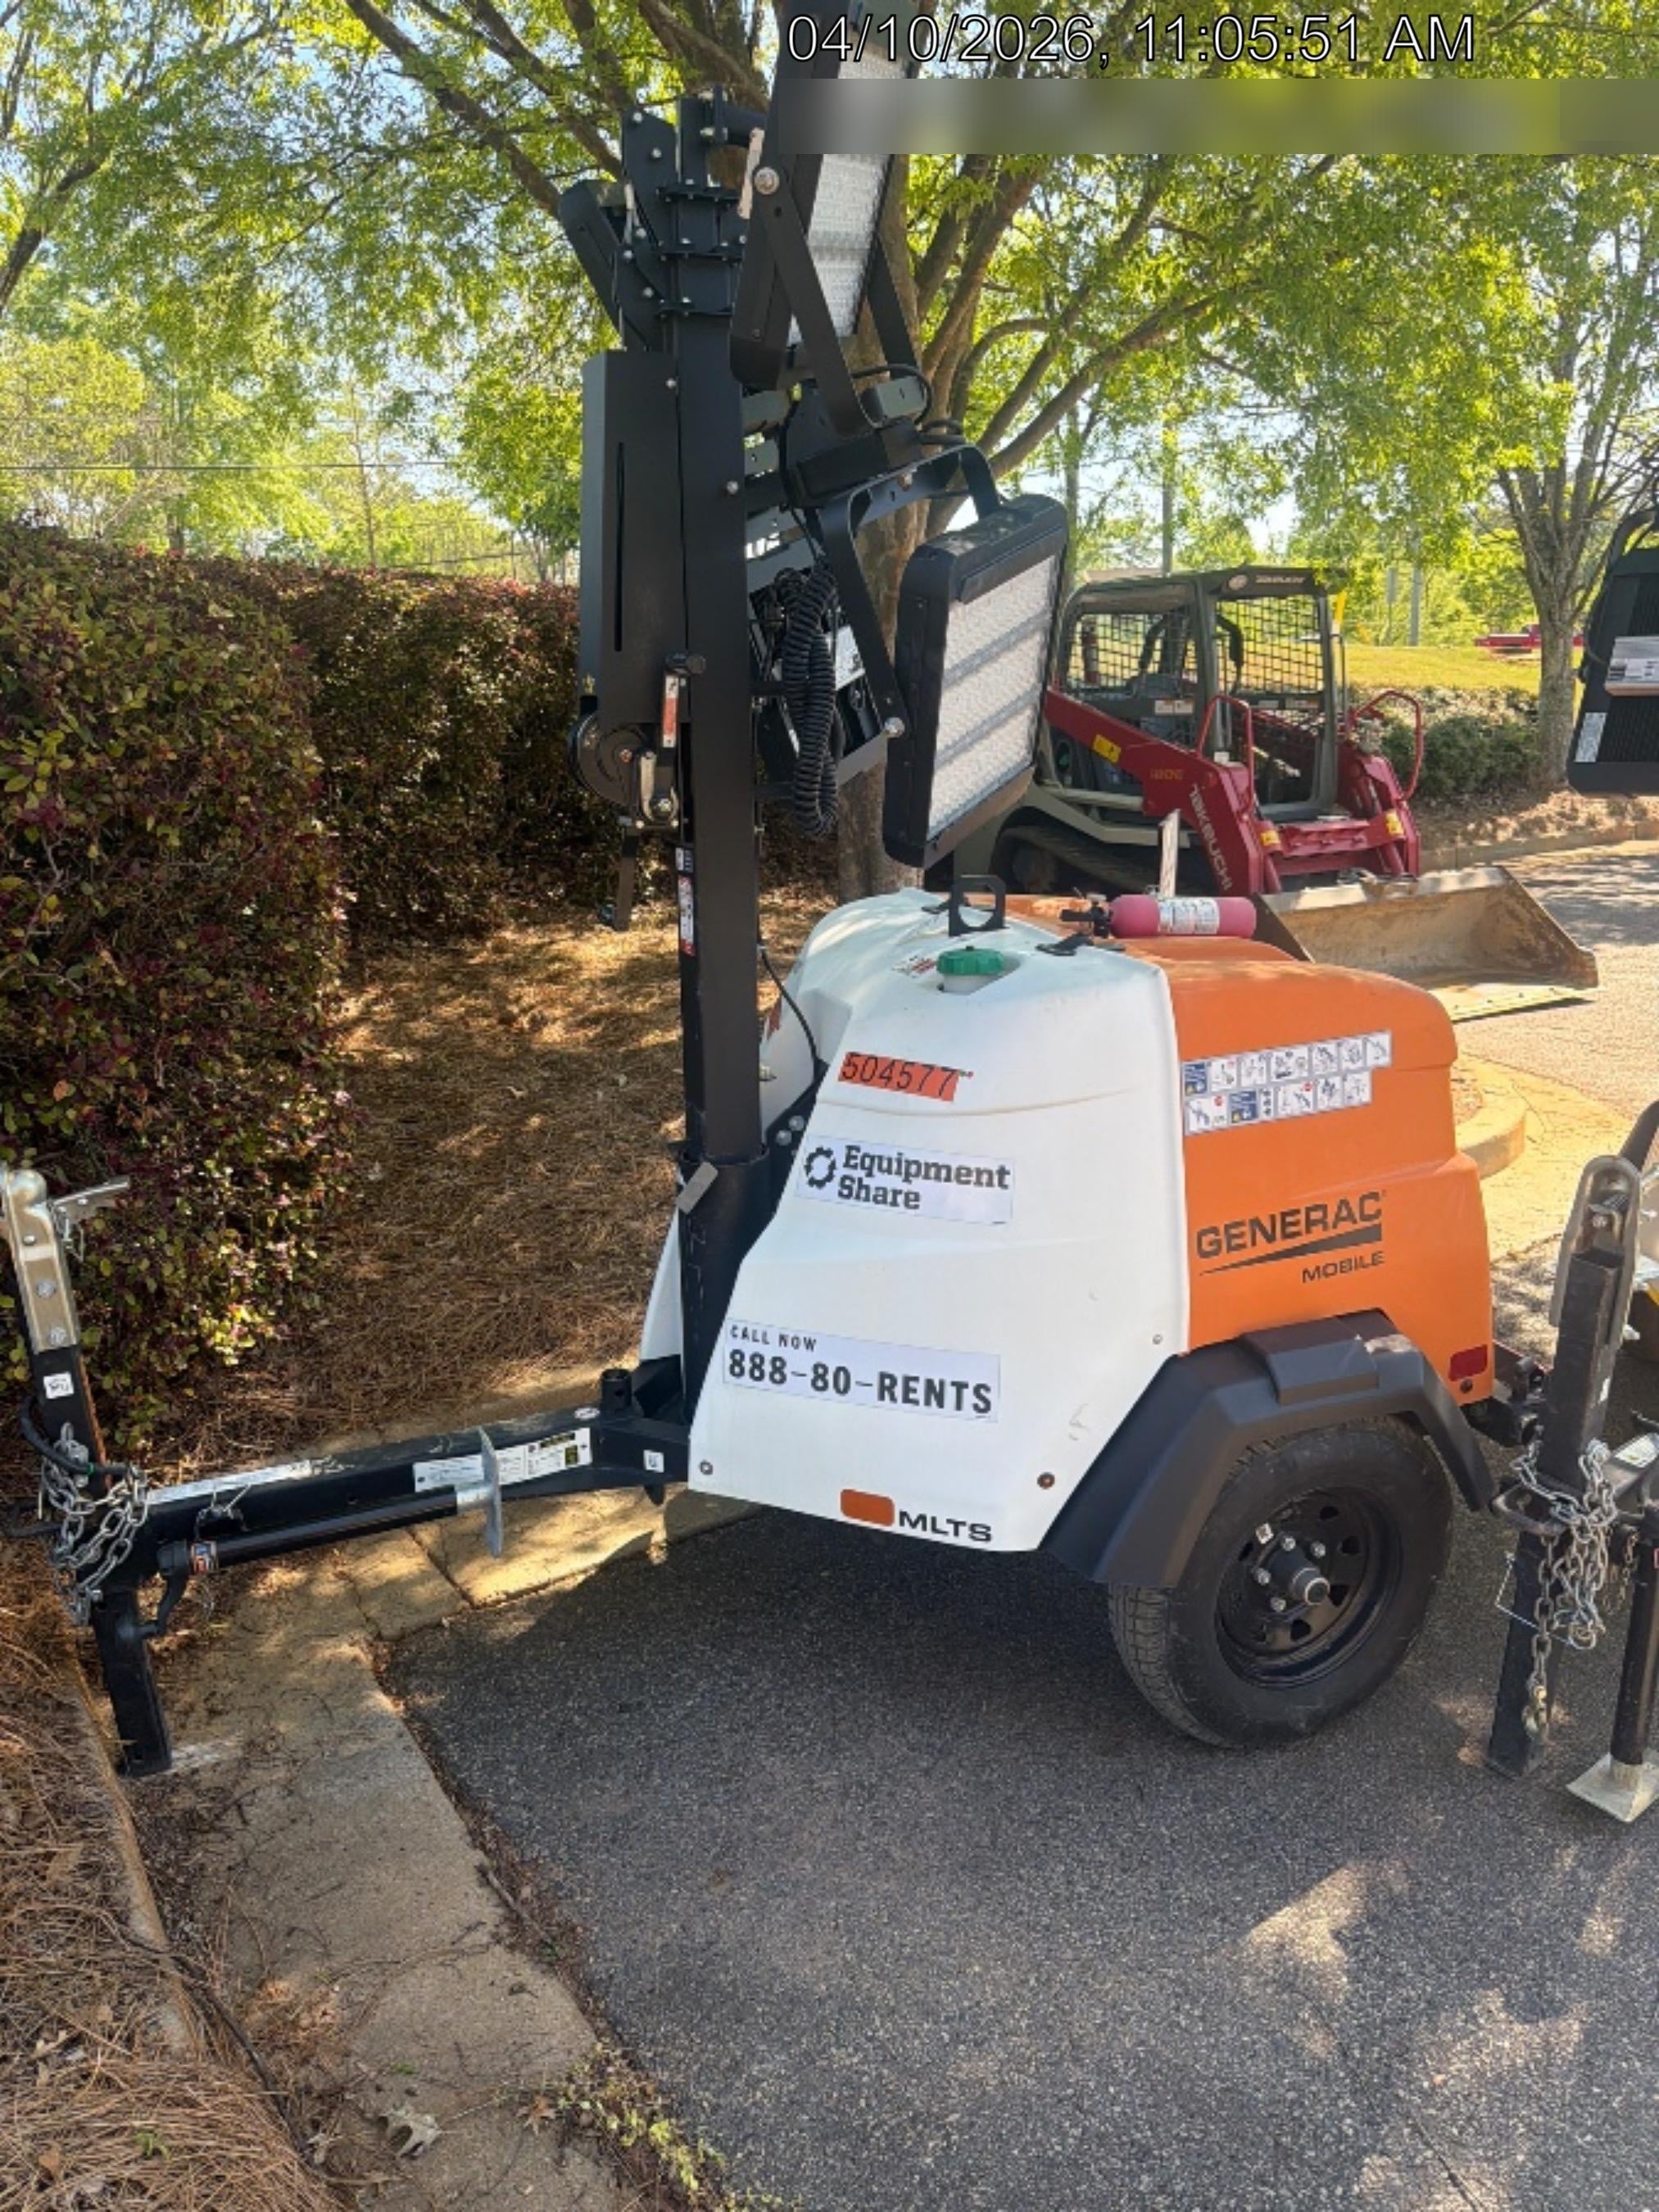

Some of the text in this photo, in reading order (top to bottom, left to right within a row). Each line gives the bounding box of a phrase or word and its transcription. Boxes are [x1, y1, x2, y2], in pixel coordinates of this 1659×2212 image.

[841, 1051, 959, 1097] 504577
[842, 1145, 1012, 1190] Equipment
[837, 1175, 921, 1210] Share
[1195, 1190, 1383, 1259] GENERAC
[1302, 1250, 1385, 1284] MOBILE
[730, 1324, 818, 1353] CALL NOW
[728, 1349, 993, 1415] 888-80-RENTS
[898, 1509, 994, 1543] MLTS
